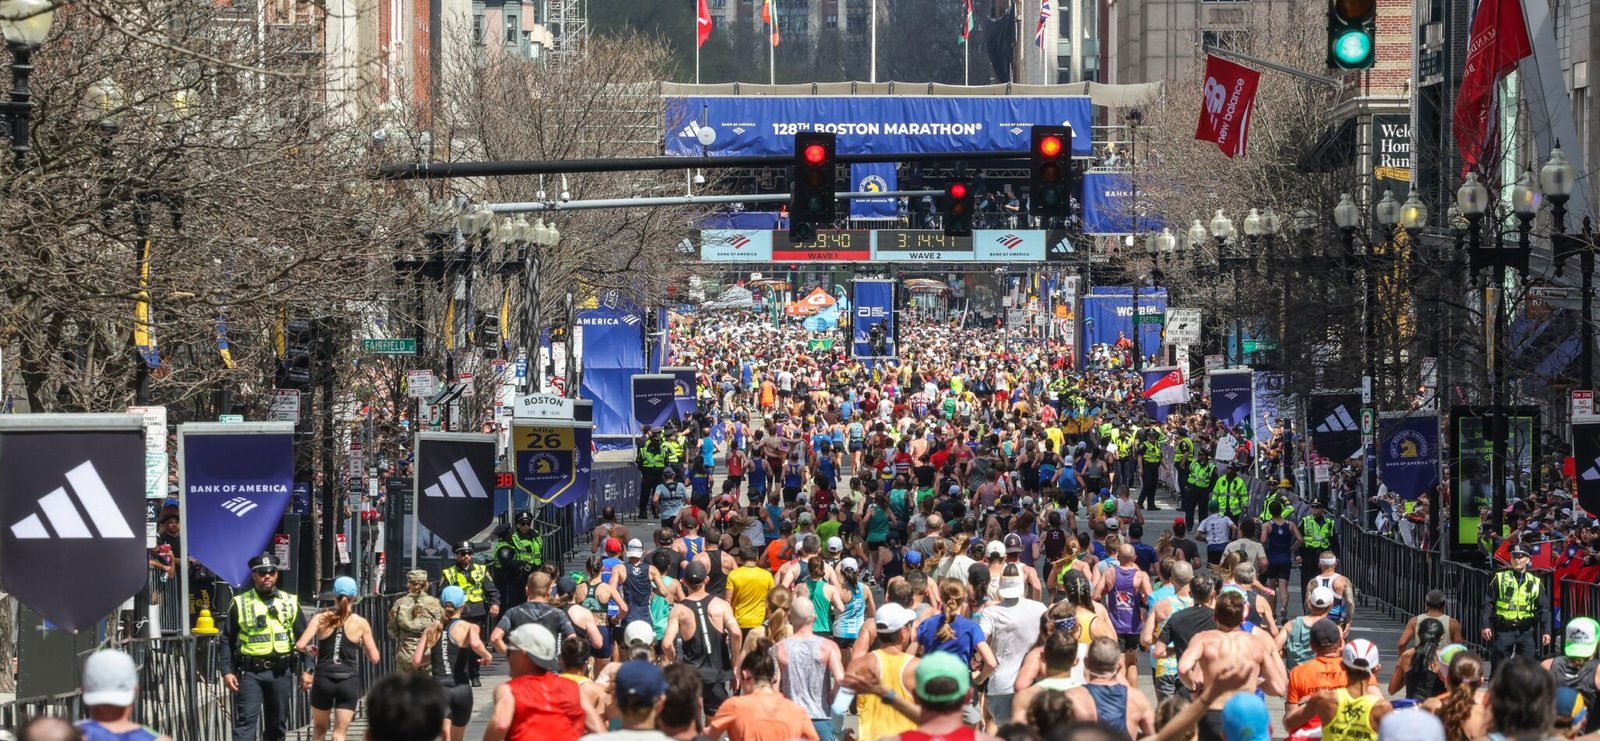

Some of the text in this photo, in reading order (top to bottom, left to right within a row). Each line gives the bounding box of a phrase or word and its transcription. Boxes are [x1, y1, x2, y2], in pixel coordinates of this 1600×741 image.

[1217, 78, 1245, 144] new balance
[772, 123, 810, 135] 128TH
[814, 123, 879, 135] BOSTON
[807, 252, 834, 260] WAVE
[909, 252, 942, 260] WAVE 2
[1116, 306, 1145, 316] WCB
[364, 340, 406, 351] FAIRFIELD
[524, 397, 564, 407] BOSTON
[526, 434, 562, 449] 26
[496, 473, 513, 487] 38
[190, 484, 288, 493] BANK OF AMERICA
